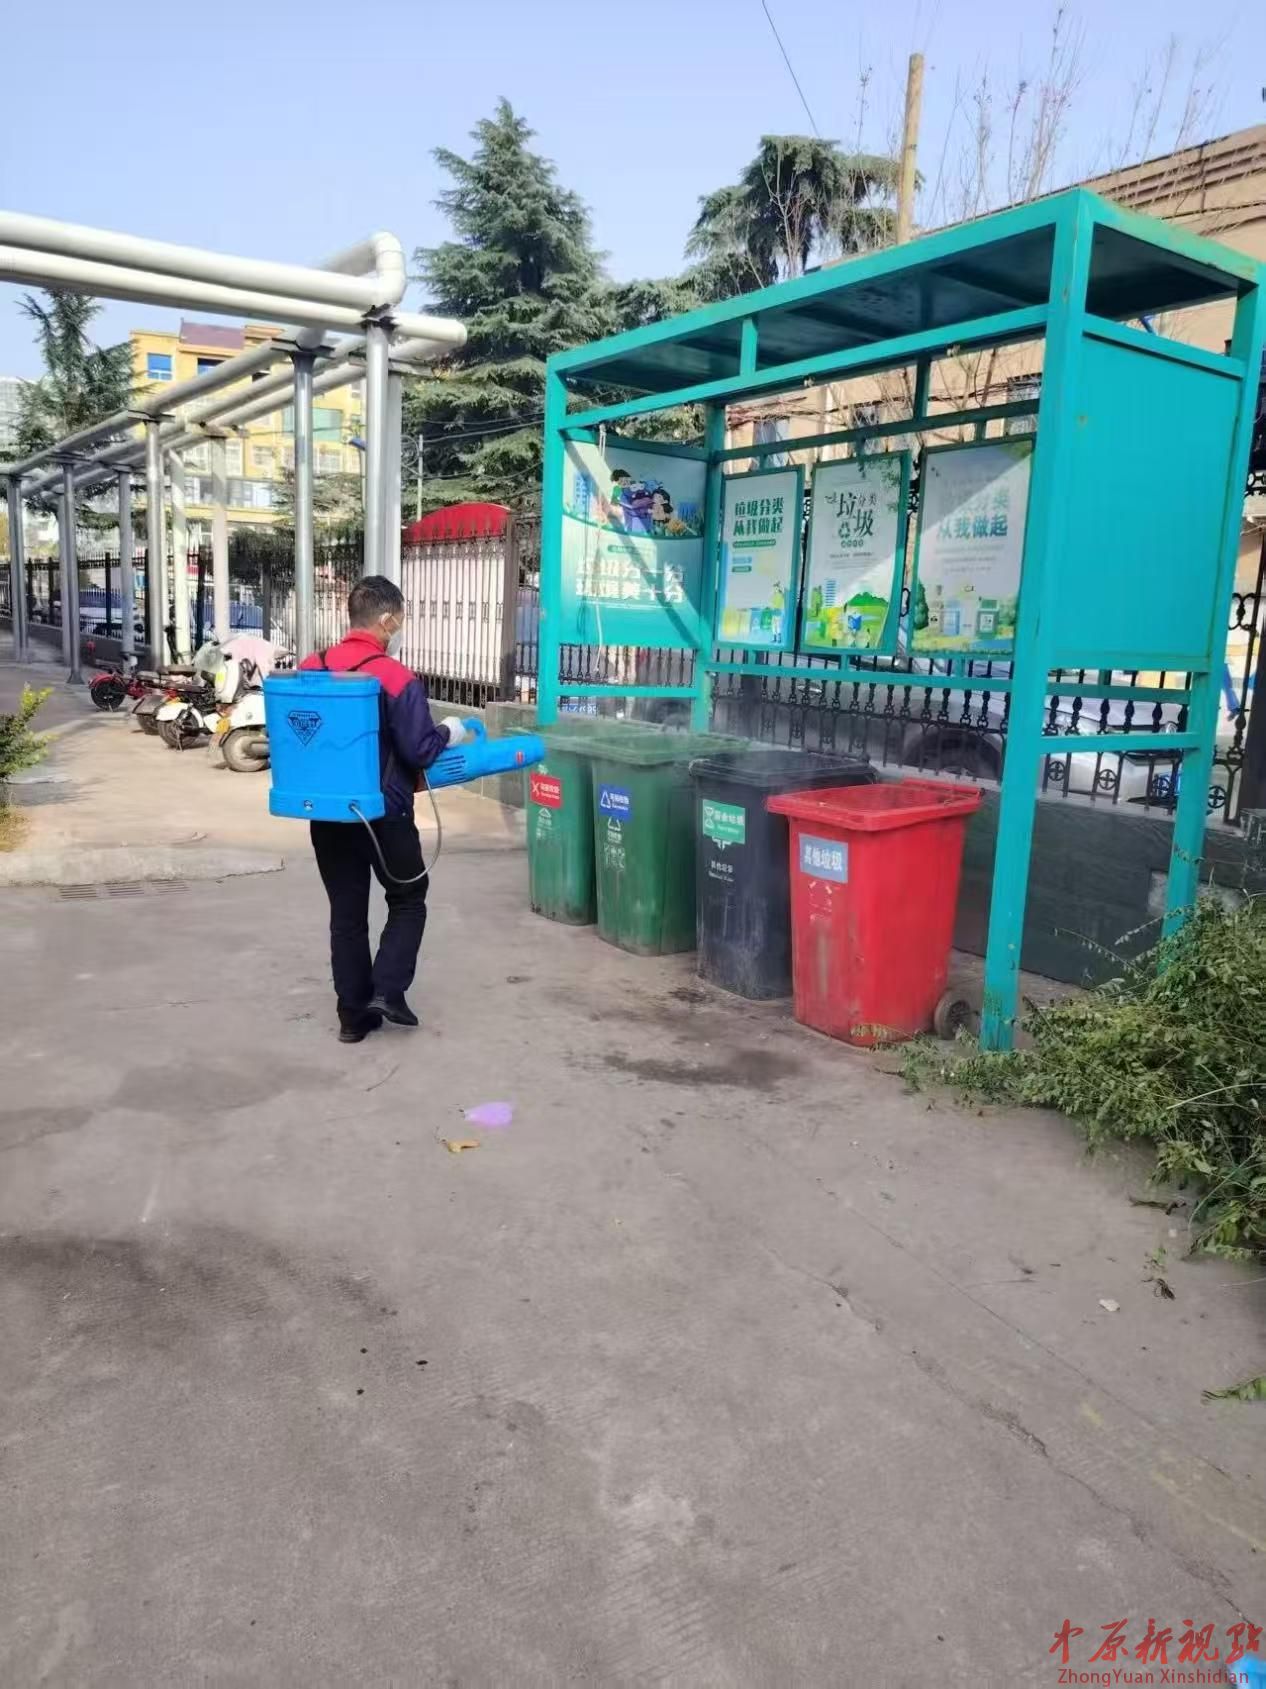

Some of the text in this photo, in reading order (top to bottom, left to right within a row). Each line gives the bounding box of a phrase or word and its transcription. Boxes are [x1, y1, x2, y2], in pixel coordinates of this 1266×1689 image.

[735, 497, 783, 517] 垃圾分类
[937, 514, 1008, 540] 从我做起
